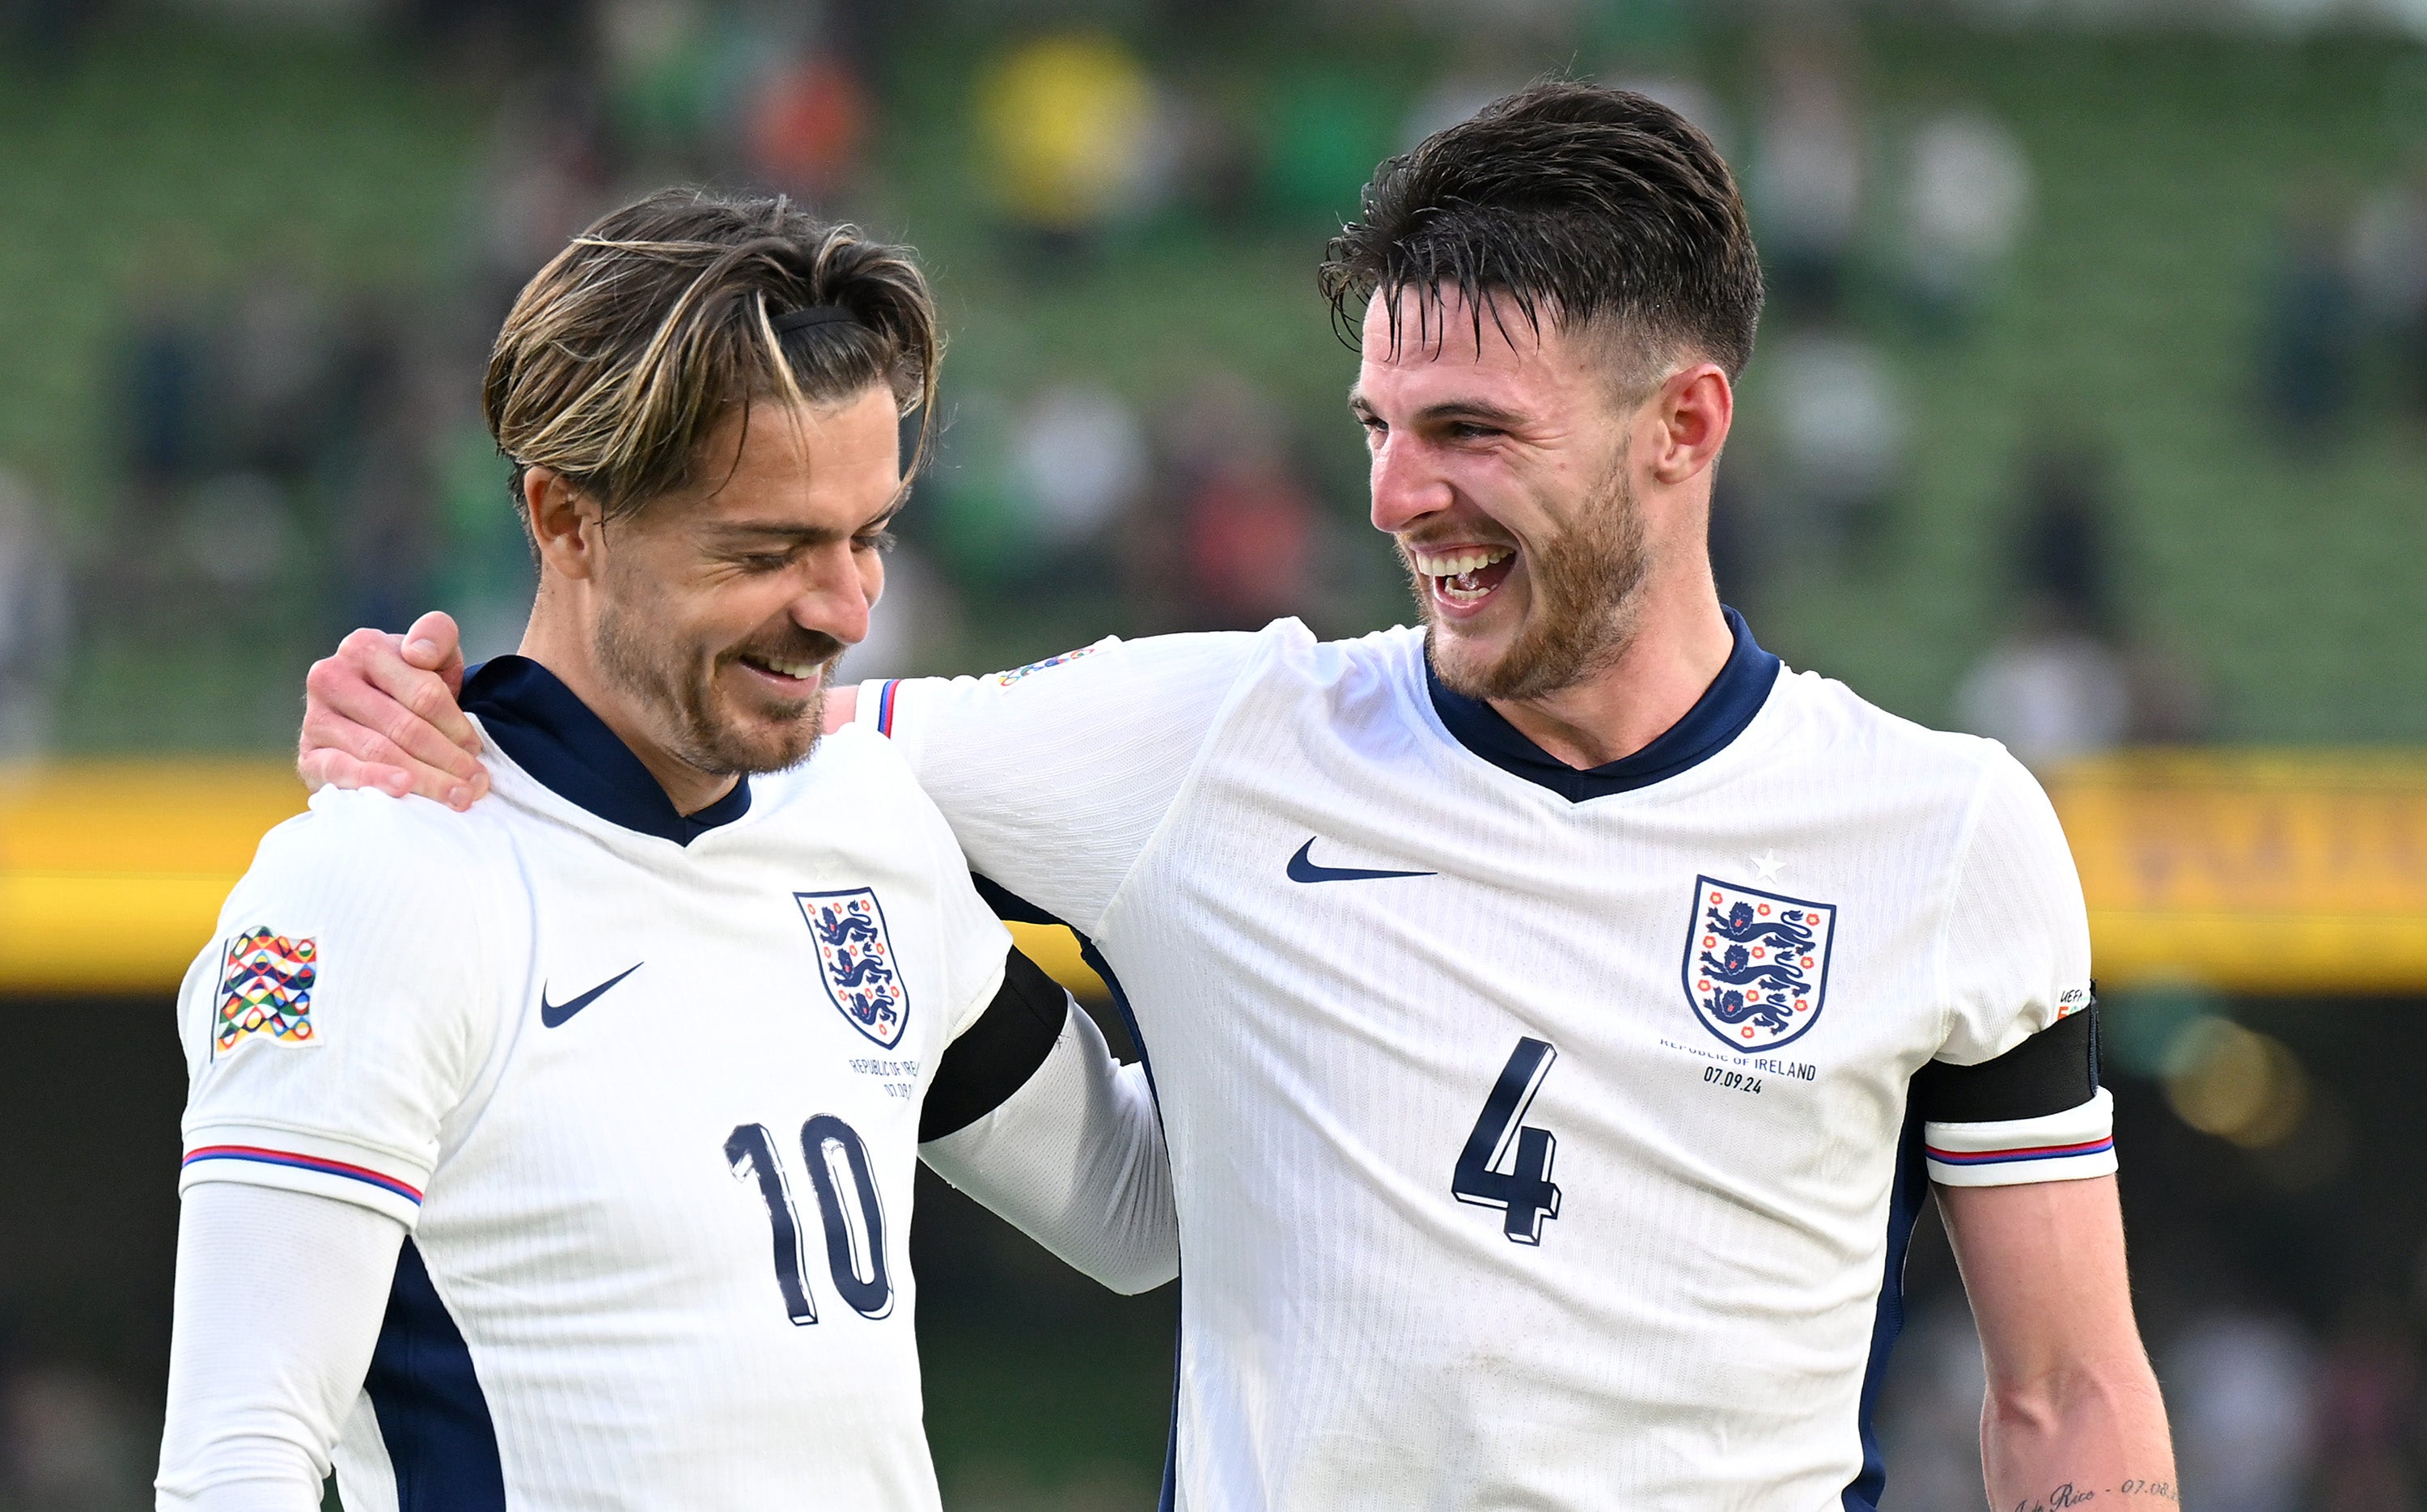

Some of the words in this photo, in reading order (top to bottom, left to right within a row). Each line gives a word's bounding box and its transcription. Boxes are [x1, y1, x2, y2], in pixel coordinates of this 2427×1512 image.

[849, 1059, 890, 1077] REPUBLIC
[889, 1061, 901, 1076] OF
[1704, 1065, 1763, 1095] 07.09.24
[1734, 1057, 1751, 1066] OF
[1755, 1058, 1816, 1082] IRELAND
[1451, 1036, 1561, 1247] 4
[722, 1113, 895, 1326] 10
